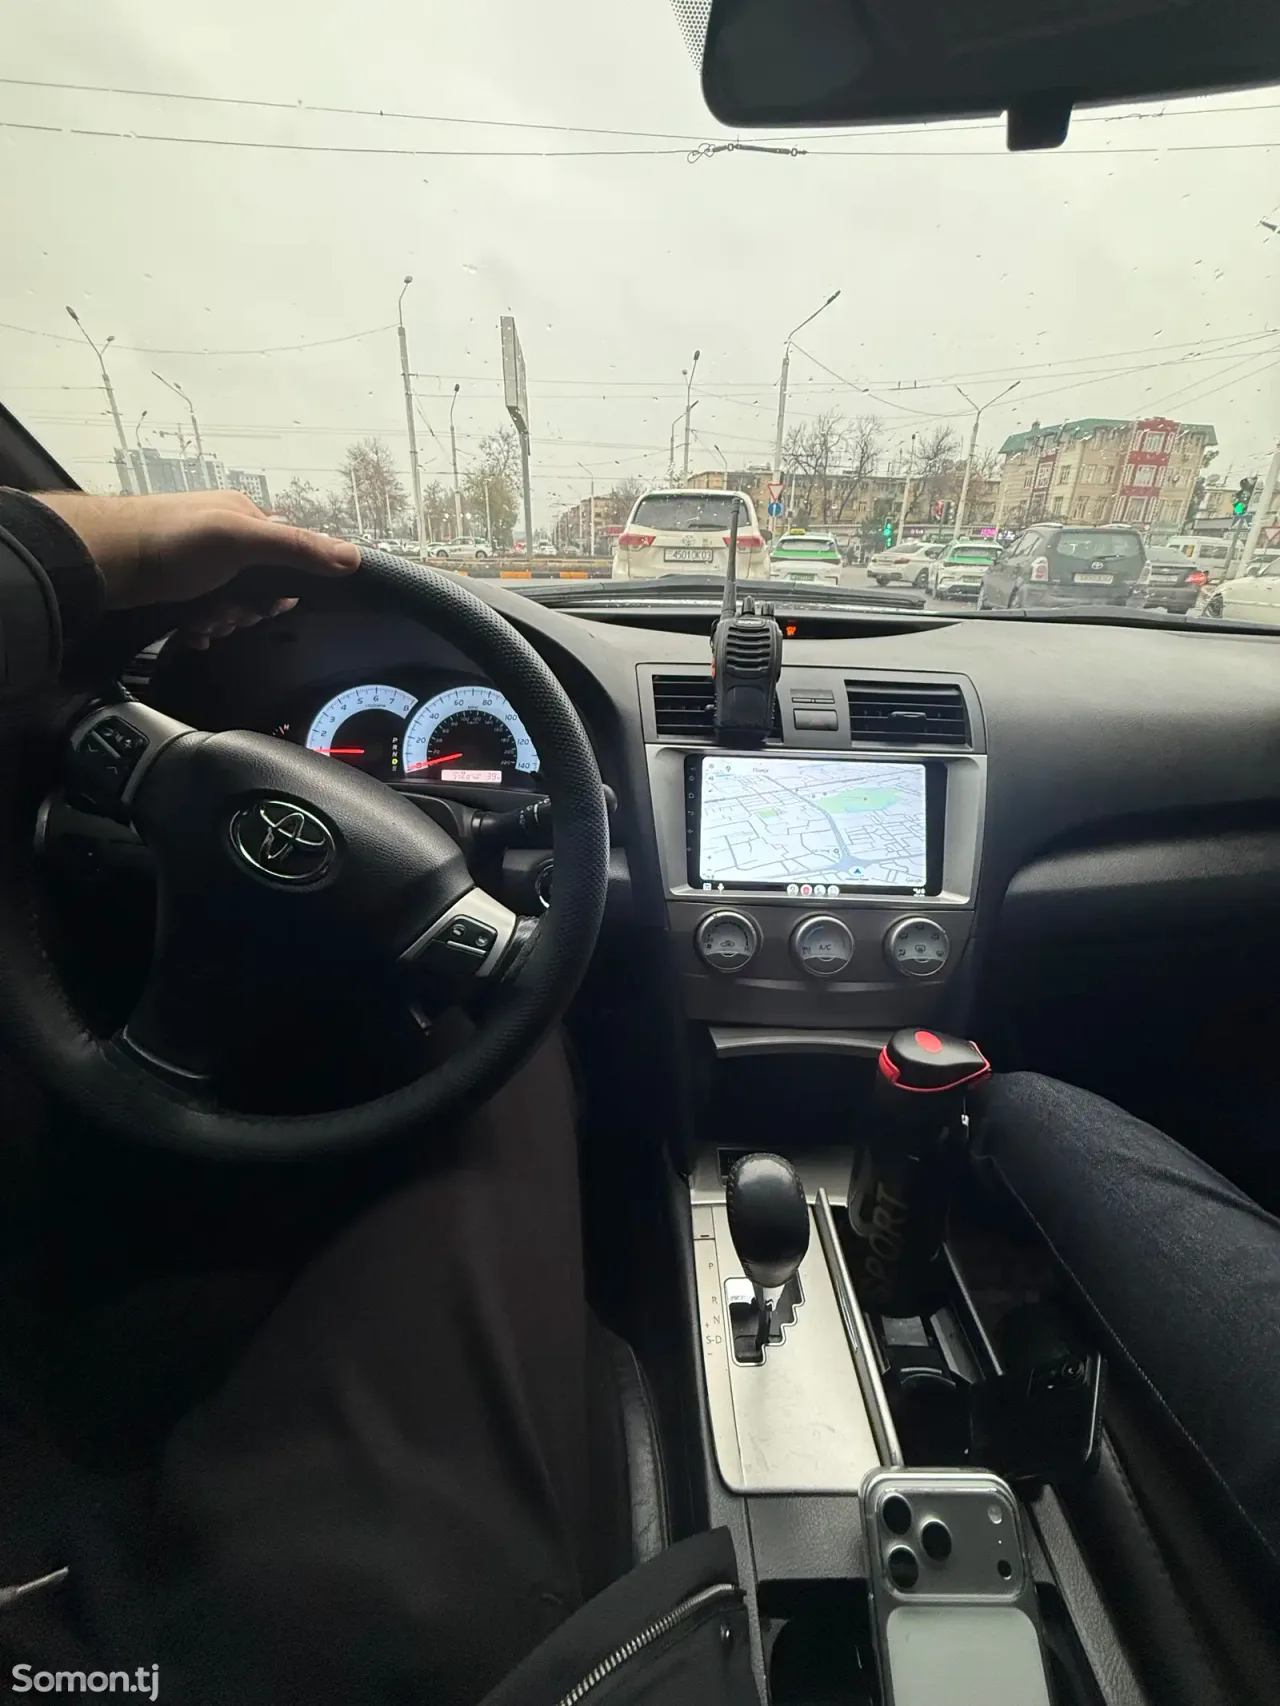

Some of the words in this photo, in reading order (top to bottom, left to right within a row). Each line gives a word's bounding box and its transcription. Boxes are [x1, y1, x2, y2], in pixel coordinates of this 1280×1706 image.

[708, 1262, 714, 1270] P
[712, 1296, 718, 1304] R
[713, 1315, 720, 1324] N
